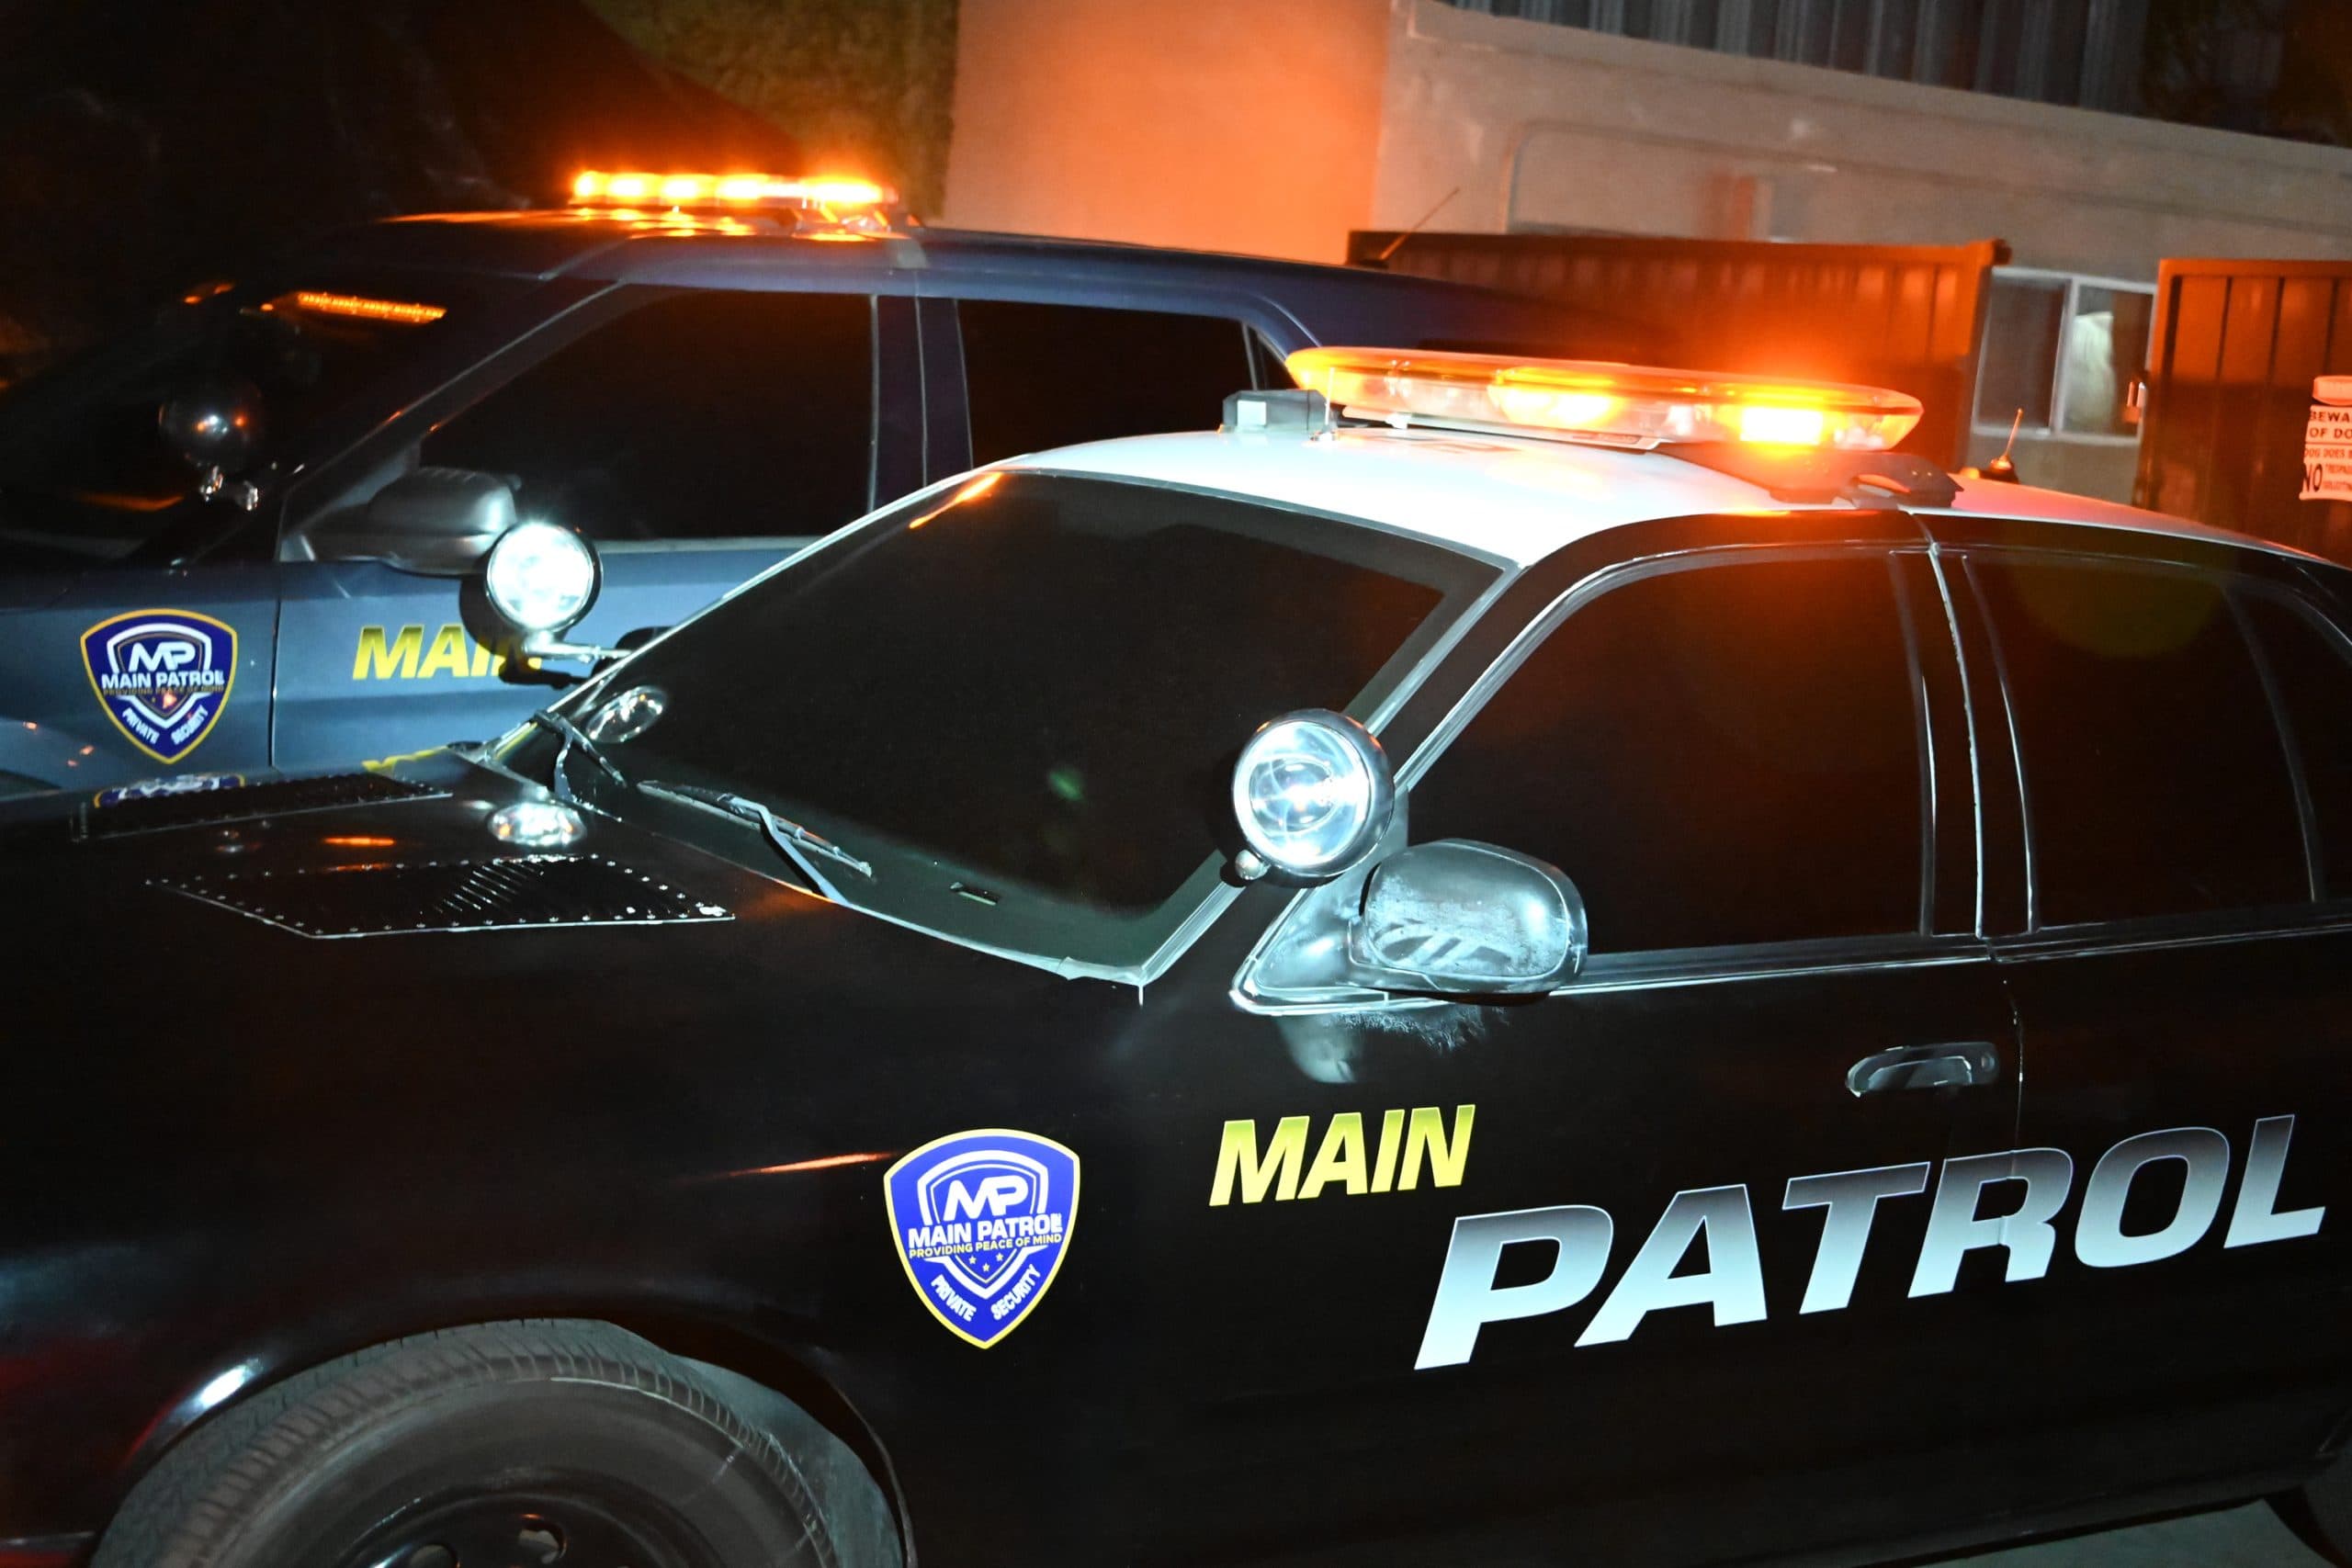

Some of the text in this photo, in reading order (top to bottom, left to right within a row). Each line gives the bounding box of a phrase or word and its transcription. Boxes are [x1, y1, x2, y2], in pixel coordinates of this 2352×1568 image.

[2309, 427, 2327, 438] OF
[2303, 463, 2323, 492] NO
[129, 641, 196, 672] MP
[101, 669, 225, 690] MAIN PATROL
[121, 706, 160, 745] PRIVATE
[1208, 1104, 1476, 1207] MAIN
[943, 1175, 1029, 1222] MP
[908, 1212, 1063, 1249] MAIN PATROL
[909, 1234, 1062, 1259] PROVIDING PEACE OF MIND
[1413, 1113, 2327, 1371] PATROL
[931, 1263, 1042, 1322] PRIVATE SECURITY
